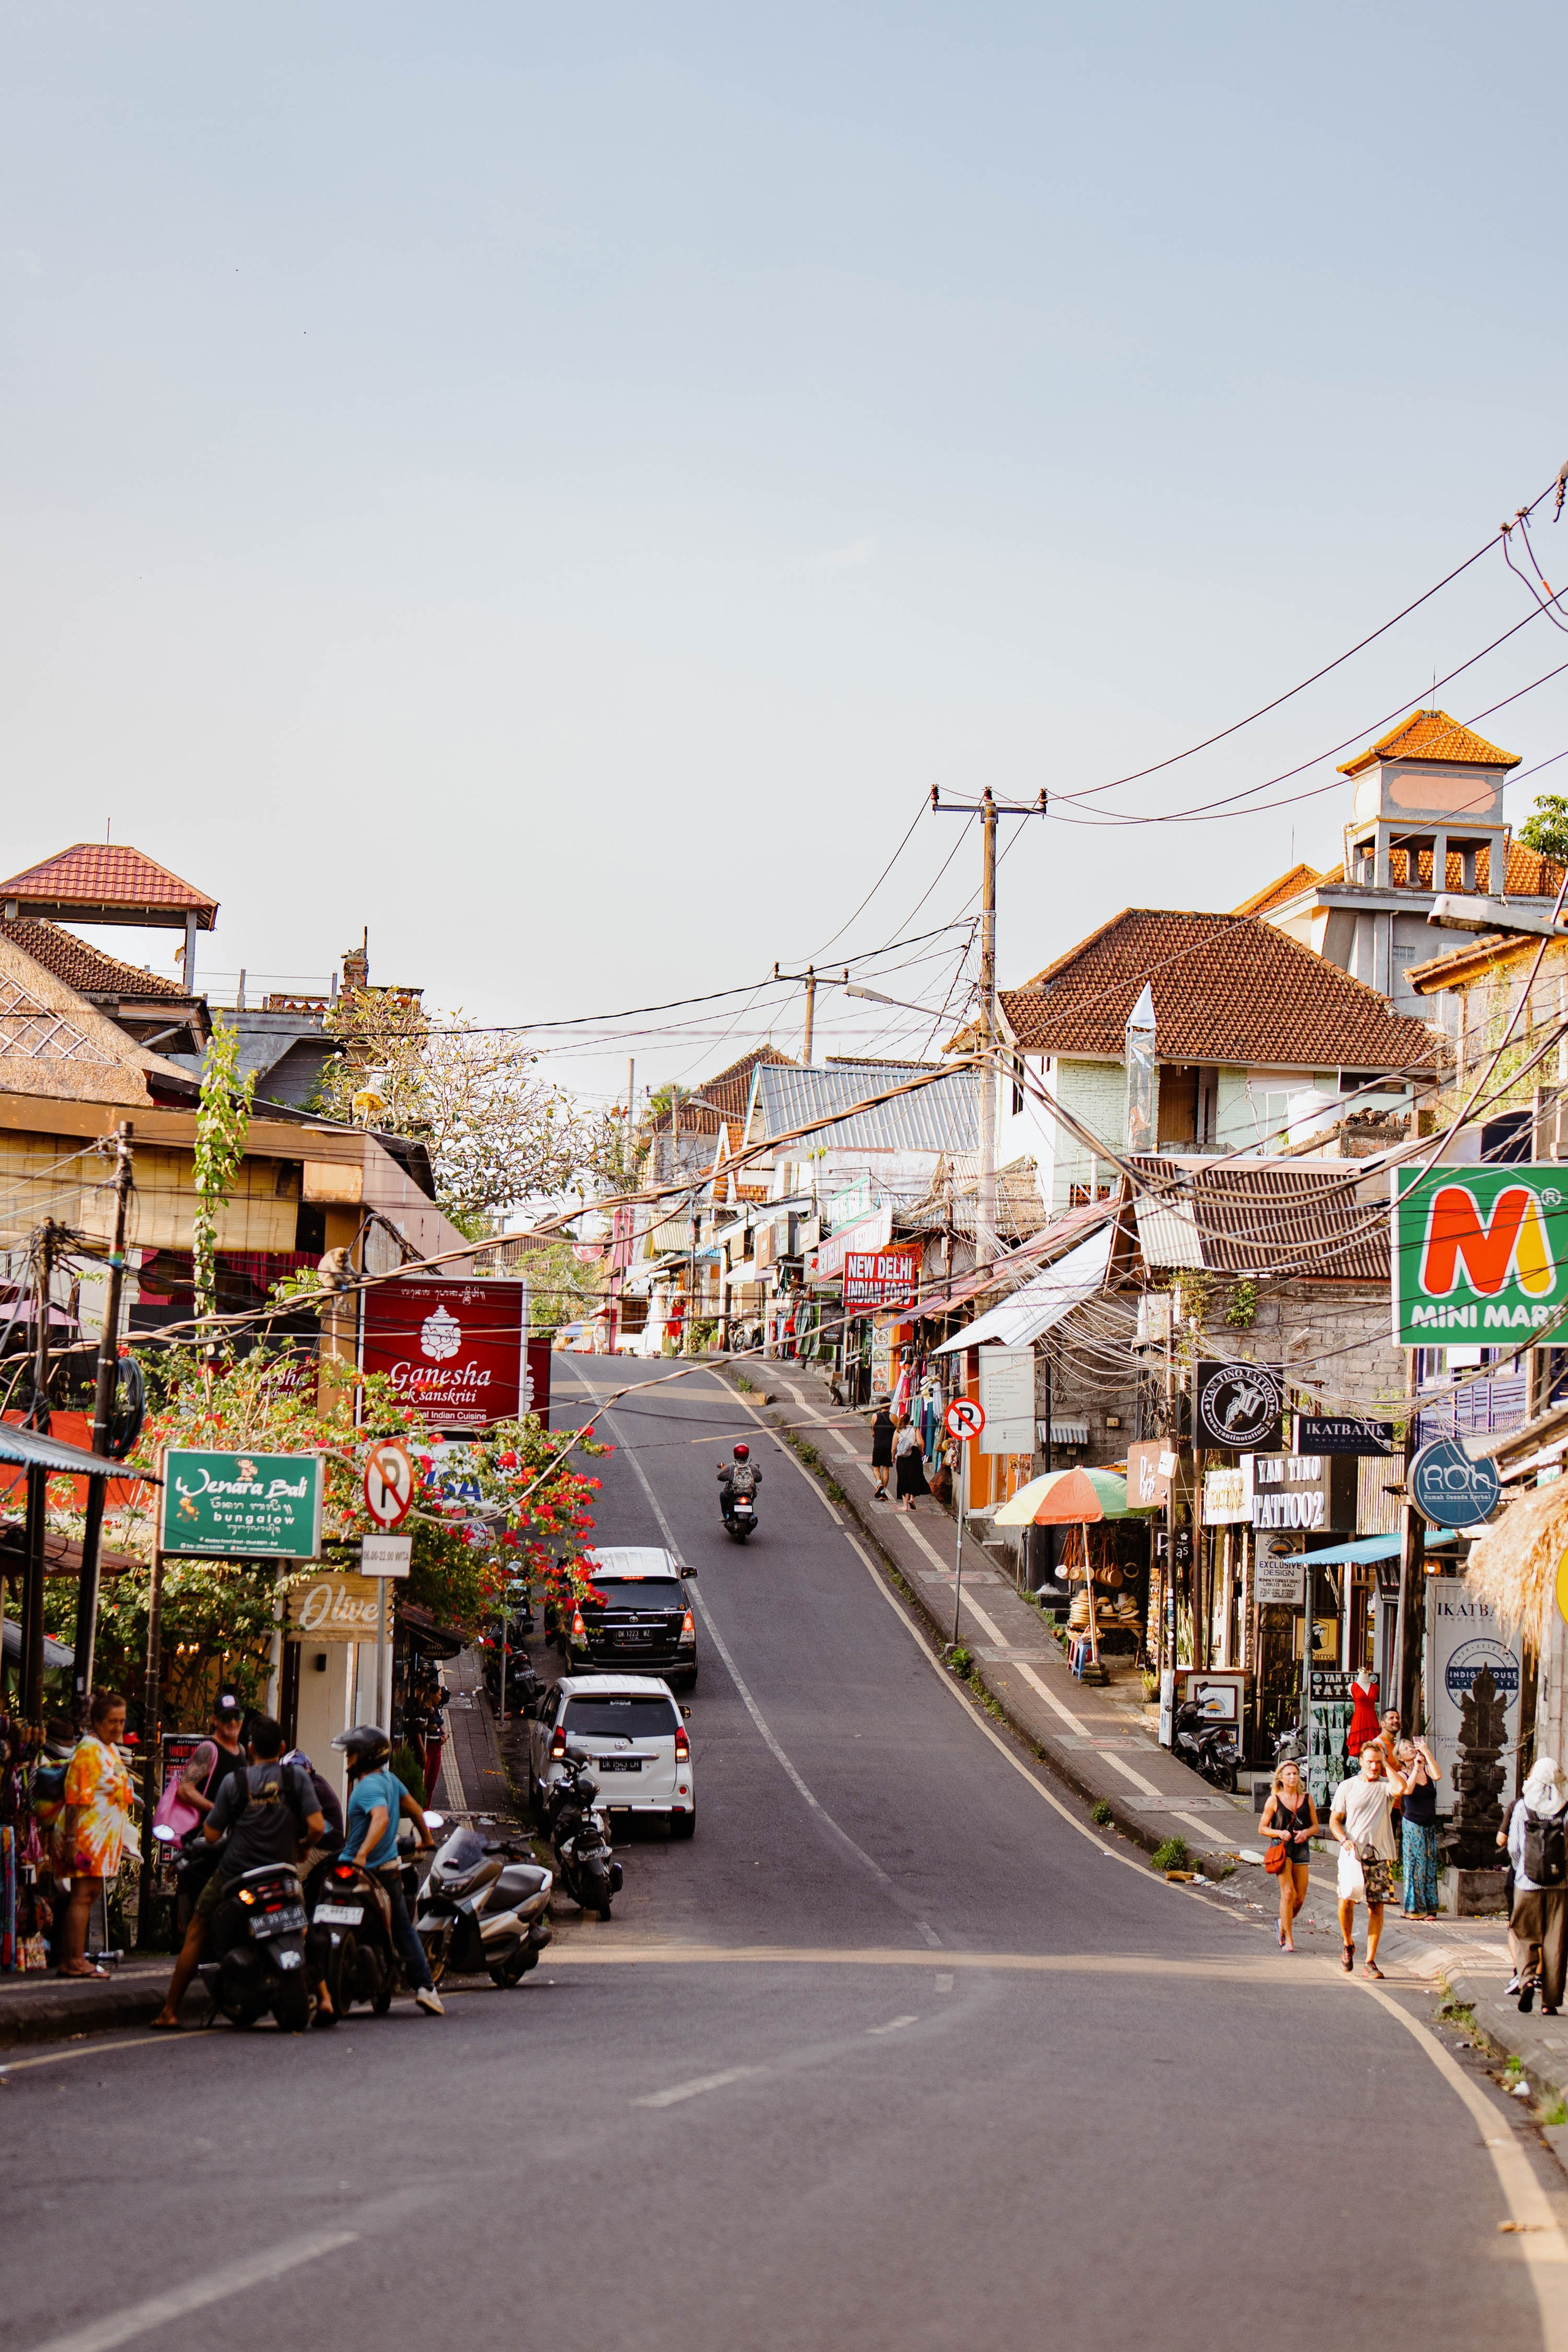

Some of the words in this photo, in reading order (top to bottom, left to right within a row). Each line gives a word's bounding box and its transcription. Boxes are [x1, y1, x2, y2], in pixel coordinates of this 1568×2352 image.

[848, 1256, 875, 1278] NEW
[878, 1256, 912, 1280] DELHI
[847, 1280, 881, 1305] INDIAN
[884, 1282, 911, 1305] FOOD
[1411, 1305, 1477, 1328] MINI
[390, 1360, 491, 1391] Ganesha
[1204, 1382, 1218, 1403] YAN
[1216, 1369, 1243, 1382] TINO
[1245, 1370, 1275, 1403] TATTOO
[419, 1389, 476, 1405] sanskriti
[431, 1411, 454, 1419] Indian
[457, 1411, 486, 1420] Cuisine
[1306, 1423, 1385, 1436] IKATBATIK
[1257, 1458, 1284, 1483] YAN
[1287, 1456, 1321, 1481] TINO
[175, 1468, 264, 1497] Wenara
[264, 1476, 308, 1500] Bali
[213, 1511, 295, 1525] bungalow
[395, 1551, 409, 1561] WITA
[1259, 1561, 1302, 1569] EXCLUSIVE
[298, 1583, 379, 1631] Olive
[1324, 1674, 1342, 1683] YAN
